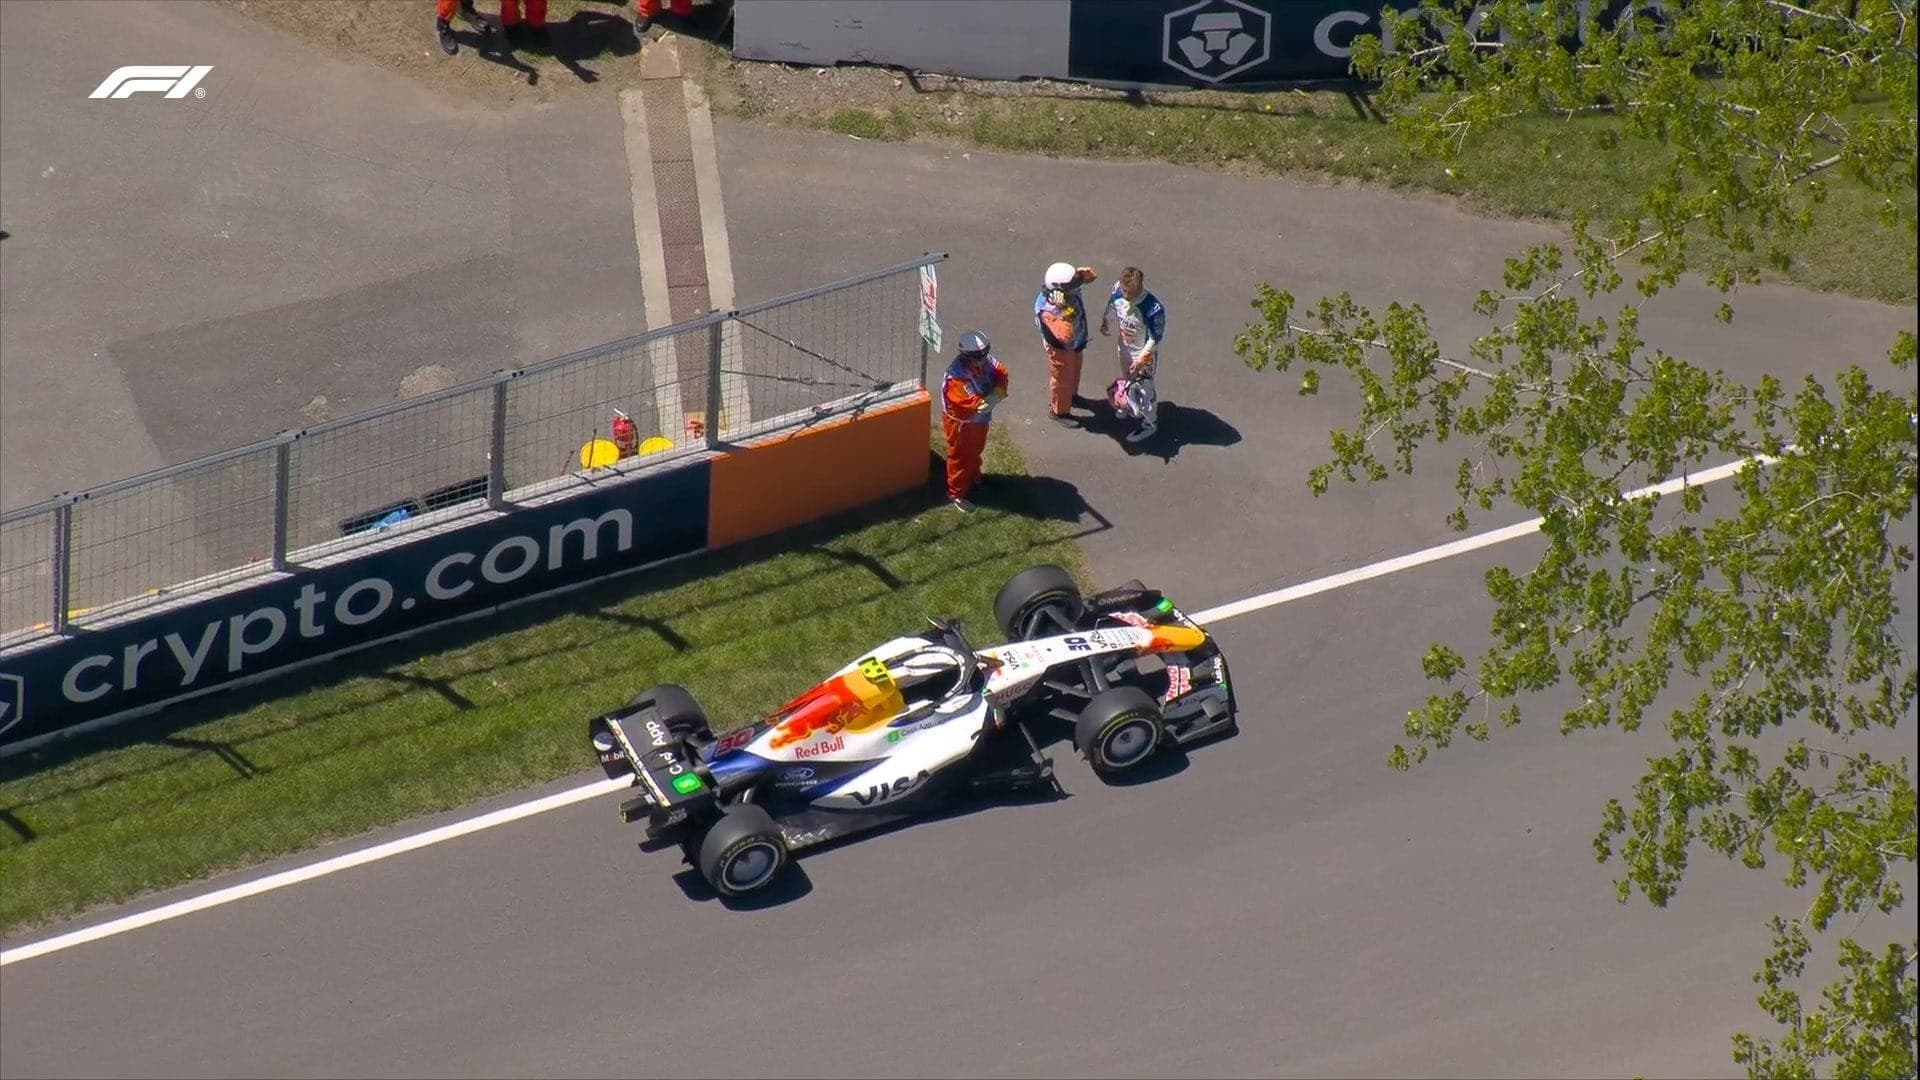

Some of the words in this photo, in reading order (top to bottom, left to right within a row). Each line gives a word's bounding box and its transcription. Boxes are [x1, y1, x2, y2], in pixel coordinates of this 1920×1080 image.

[61, 507, 632, 703] crypto.com
[1063, 637, 1092, 651] 30
[646, 721, 667, 746] App
[795, 742, 819, 759] Red
[821, 735, 845, 753] Bull
[847, 769, 931, 806] VISA
